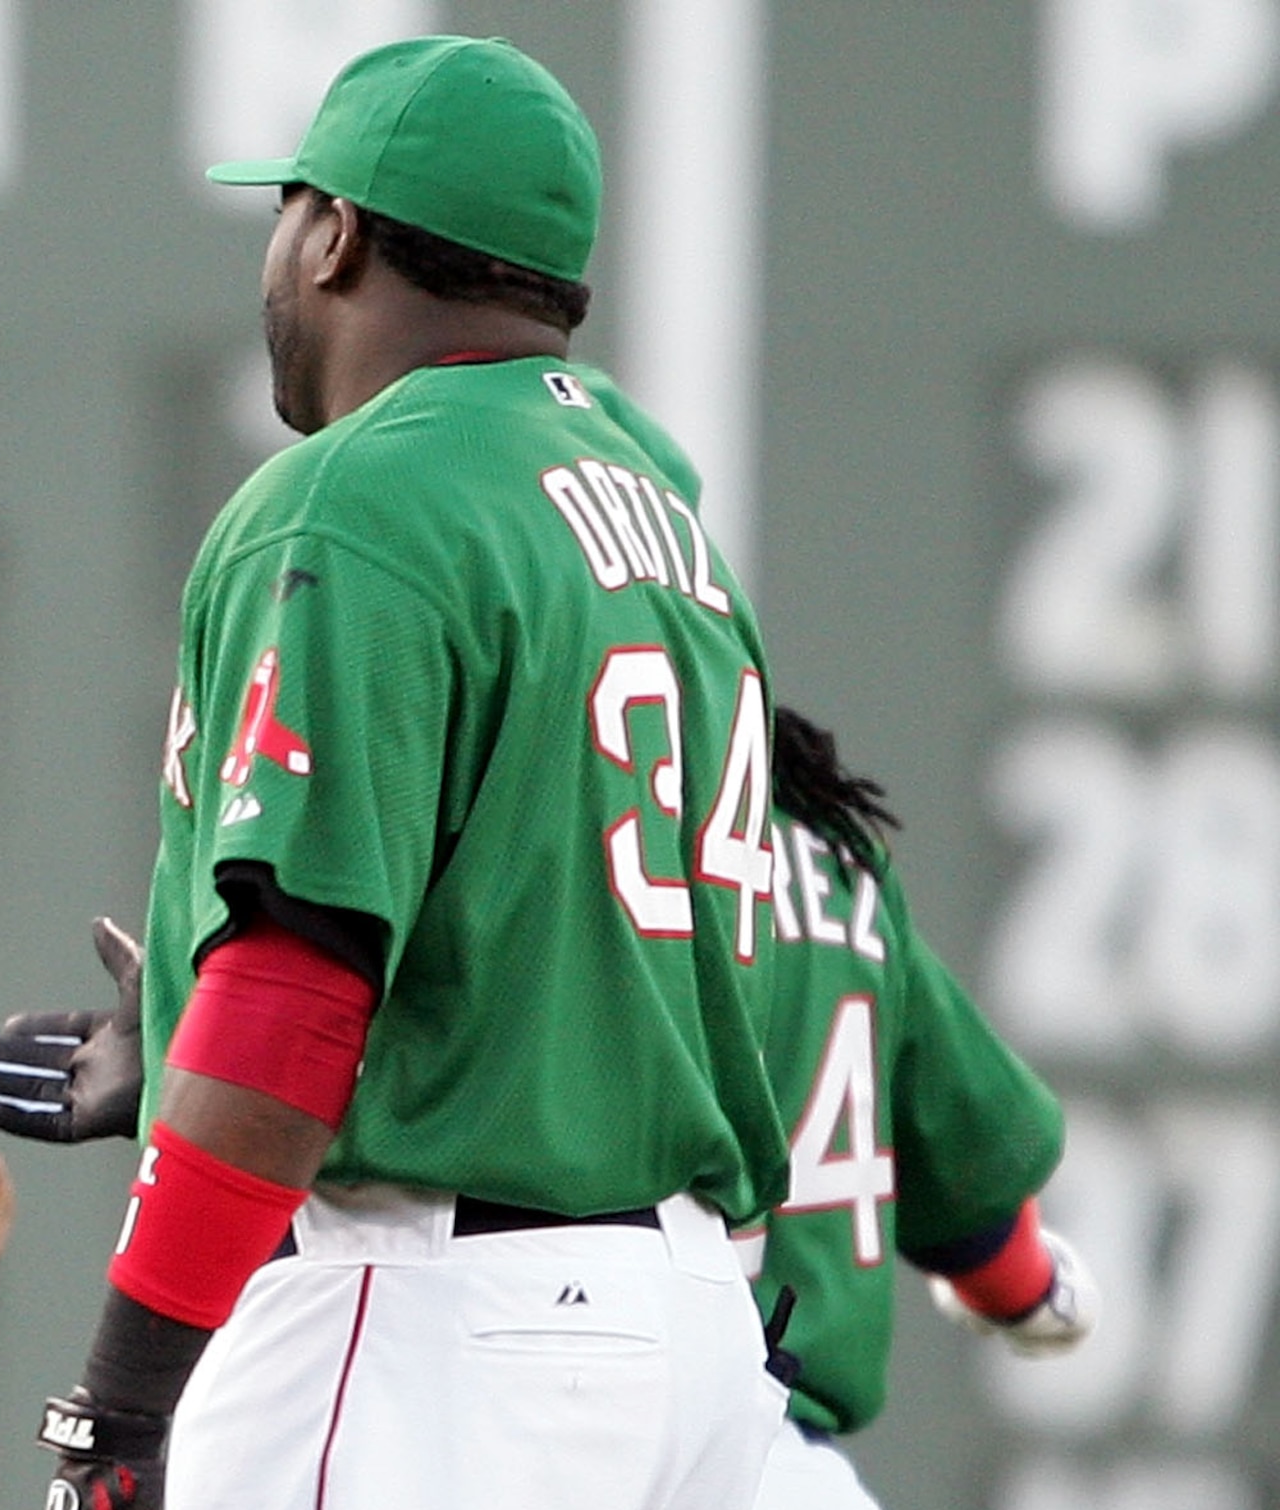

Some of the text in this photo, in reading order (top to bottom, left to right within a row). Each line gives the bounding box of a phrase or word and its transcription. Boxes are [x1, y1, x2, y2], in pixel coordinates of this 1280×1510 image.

[540, 457, 732, 618] ORTIZ
[586, 642, 773, 968] 34
[732, 992, 898, 1282] 4
